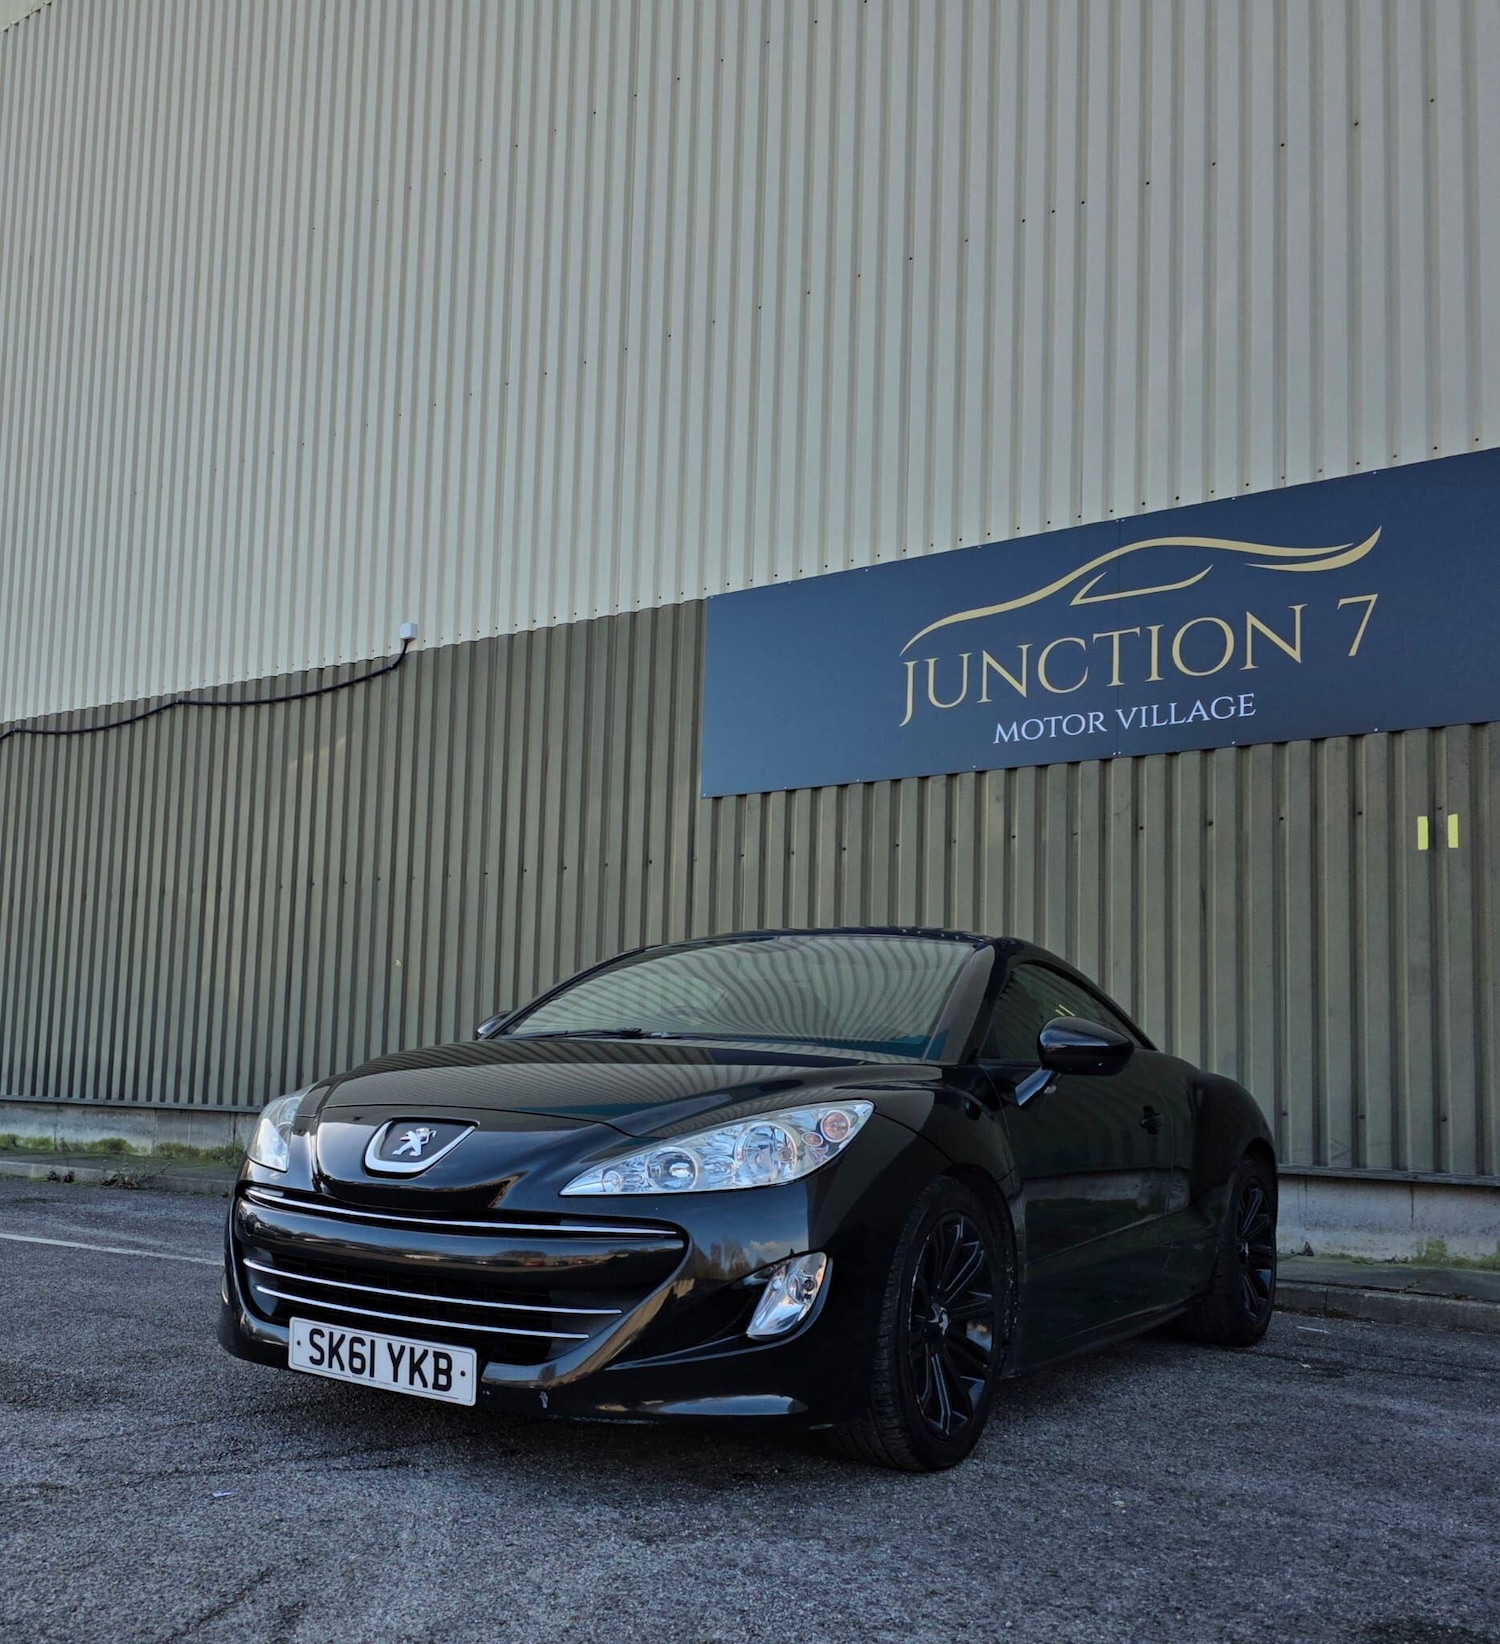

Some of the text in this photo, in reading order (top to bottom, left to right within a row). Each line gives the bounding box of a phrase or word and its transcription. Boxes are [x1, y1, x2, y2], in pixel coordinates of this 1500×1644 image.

[899, 593, 1379, 726] JUNCTION 7
[993, 692, 1256, 744] MOTOR VILLAGE
[309, 1328, 453, 1392] SK61 YKB
